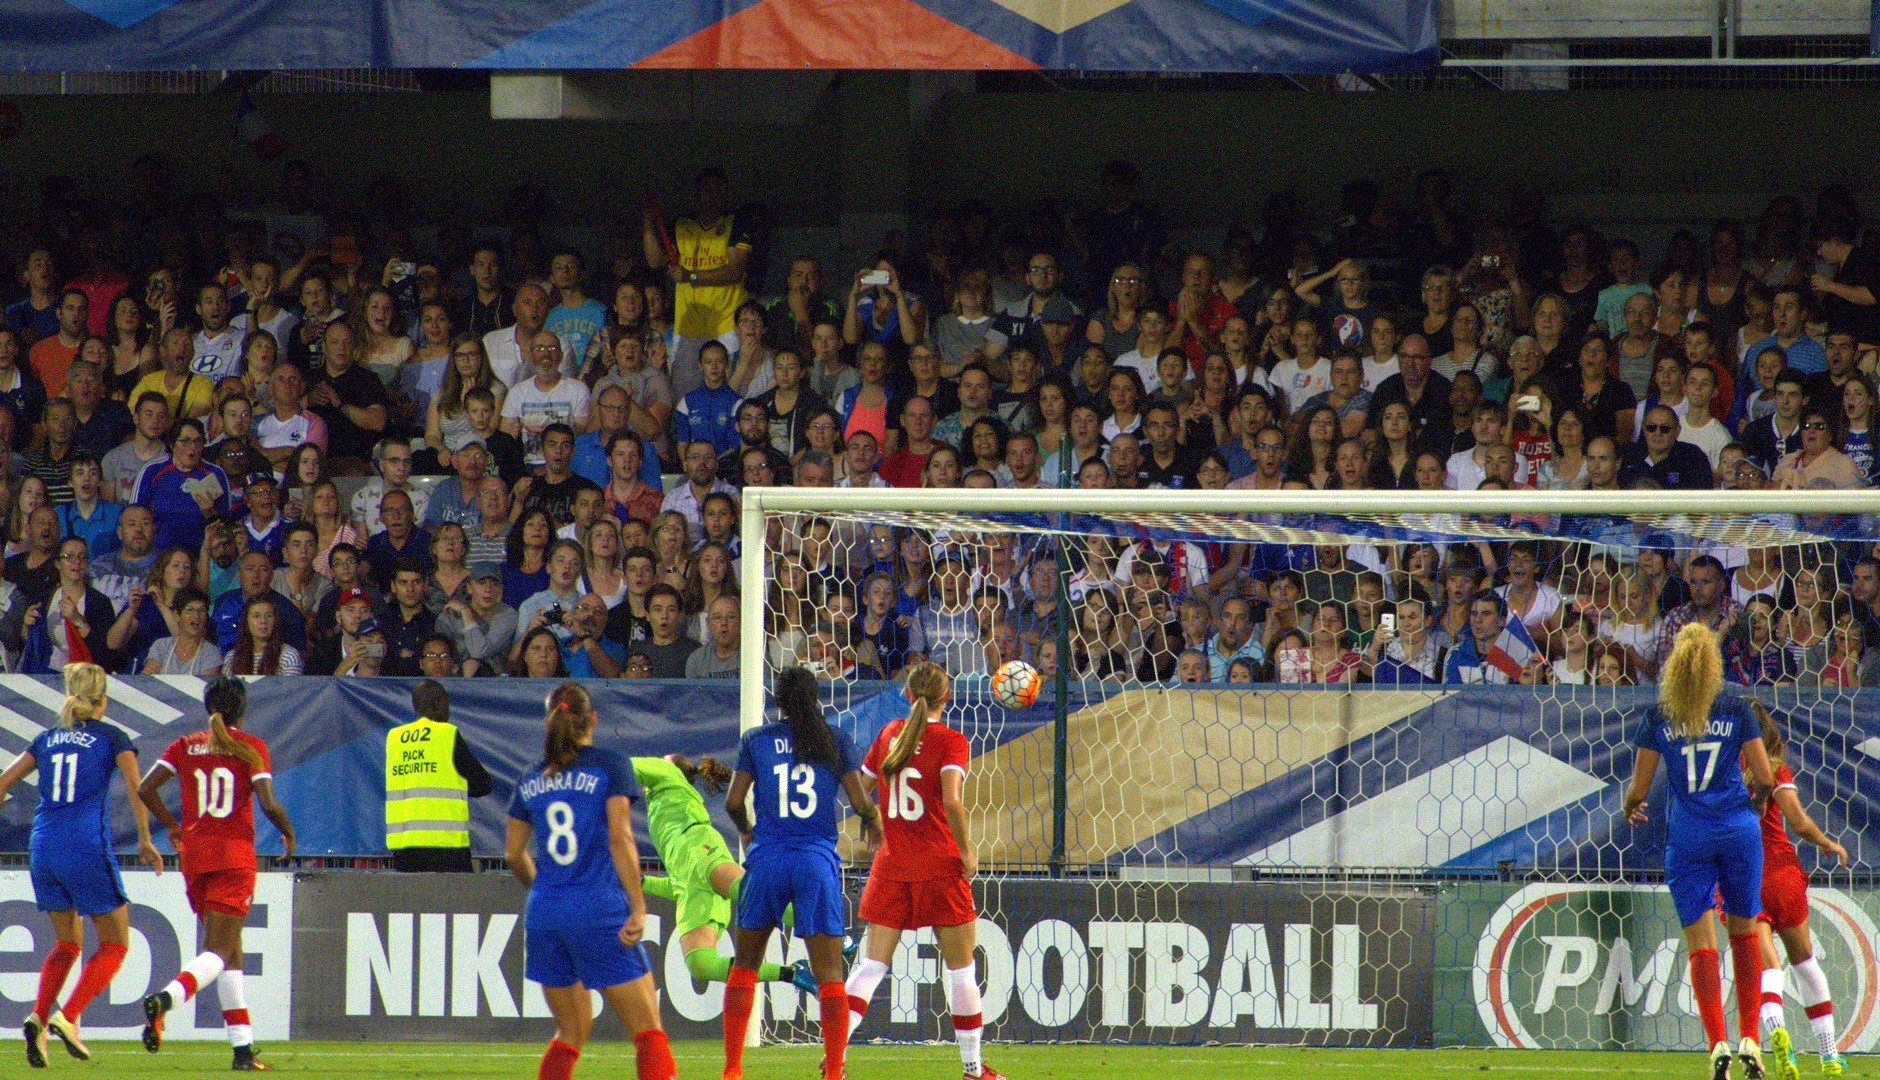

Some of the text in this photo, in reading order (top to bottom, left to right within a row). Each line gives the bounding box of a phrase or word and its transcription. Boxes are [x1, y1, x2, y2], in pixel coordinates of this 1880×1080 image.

[46, 731, 97, 748] LAVOGEZ
[400, 727, 432, 744] 002
[402, 749, 425, 761] PACK
[51, 752, 79, 803] 11
[193, 767, 235, 818] 10
[392, 762, 437, 776] SECURITE
[773, 762, 818, 819] 13
[1680, 741, 1722, 794] 17
[887, 767, 925, 821] 16
[545, 801, 578, 866] 8
